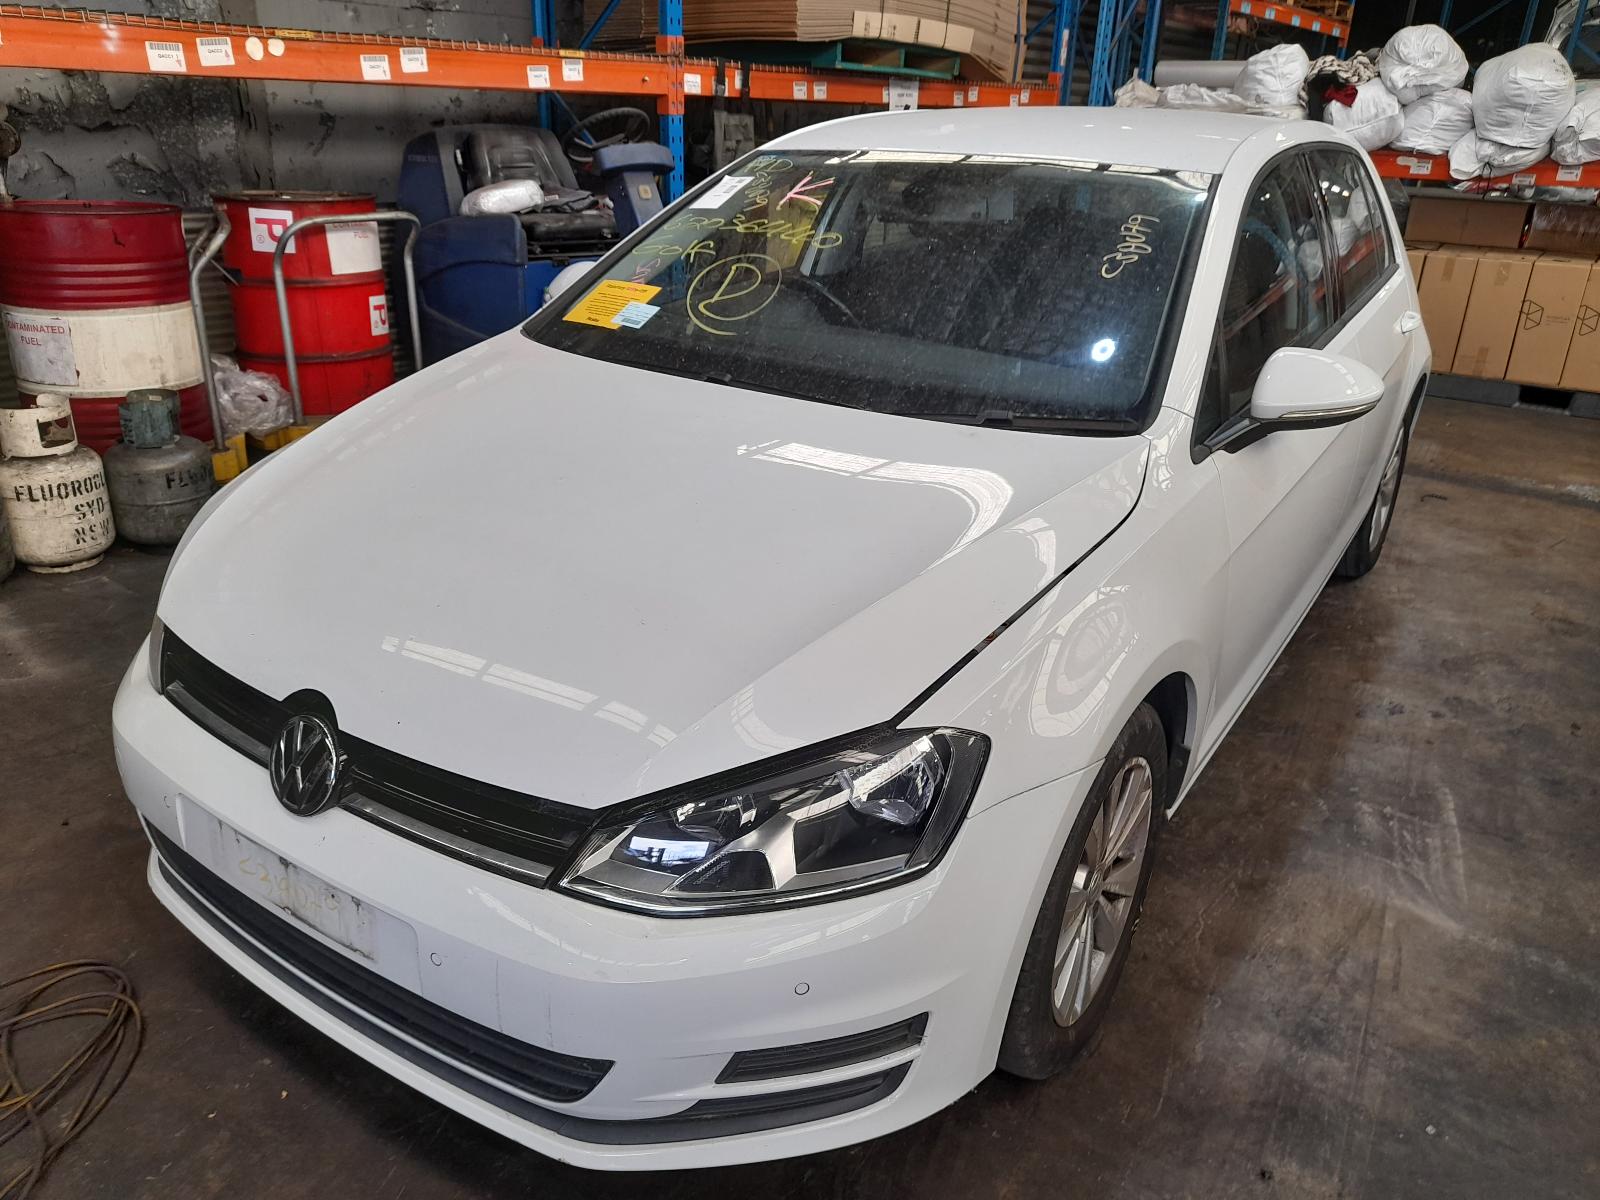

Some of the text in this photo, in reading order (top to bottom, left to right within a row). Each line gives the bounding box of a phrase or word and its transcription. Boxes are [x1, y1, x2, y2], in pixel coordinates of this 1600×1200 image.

[20, 335, 43, 346] FUEL
[74, 496, 105, 521] SYD
[73, 518, 110, 546] NSW
